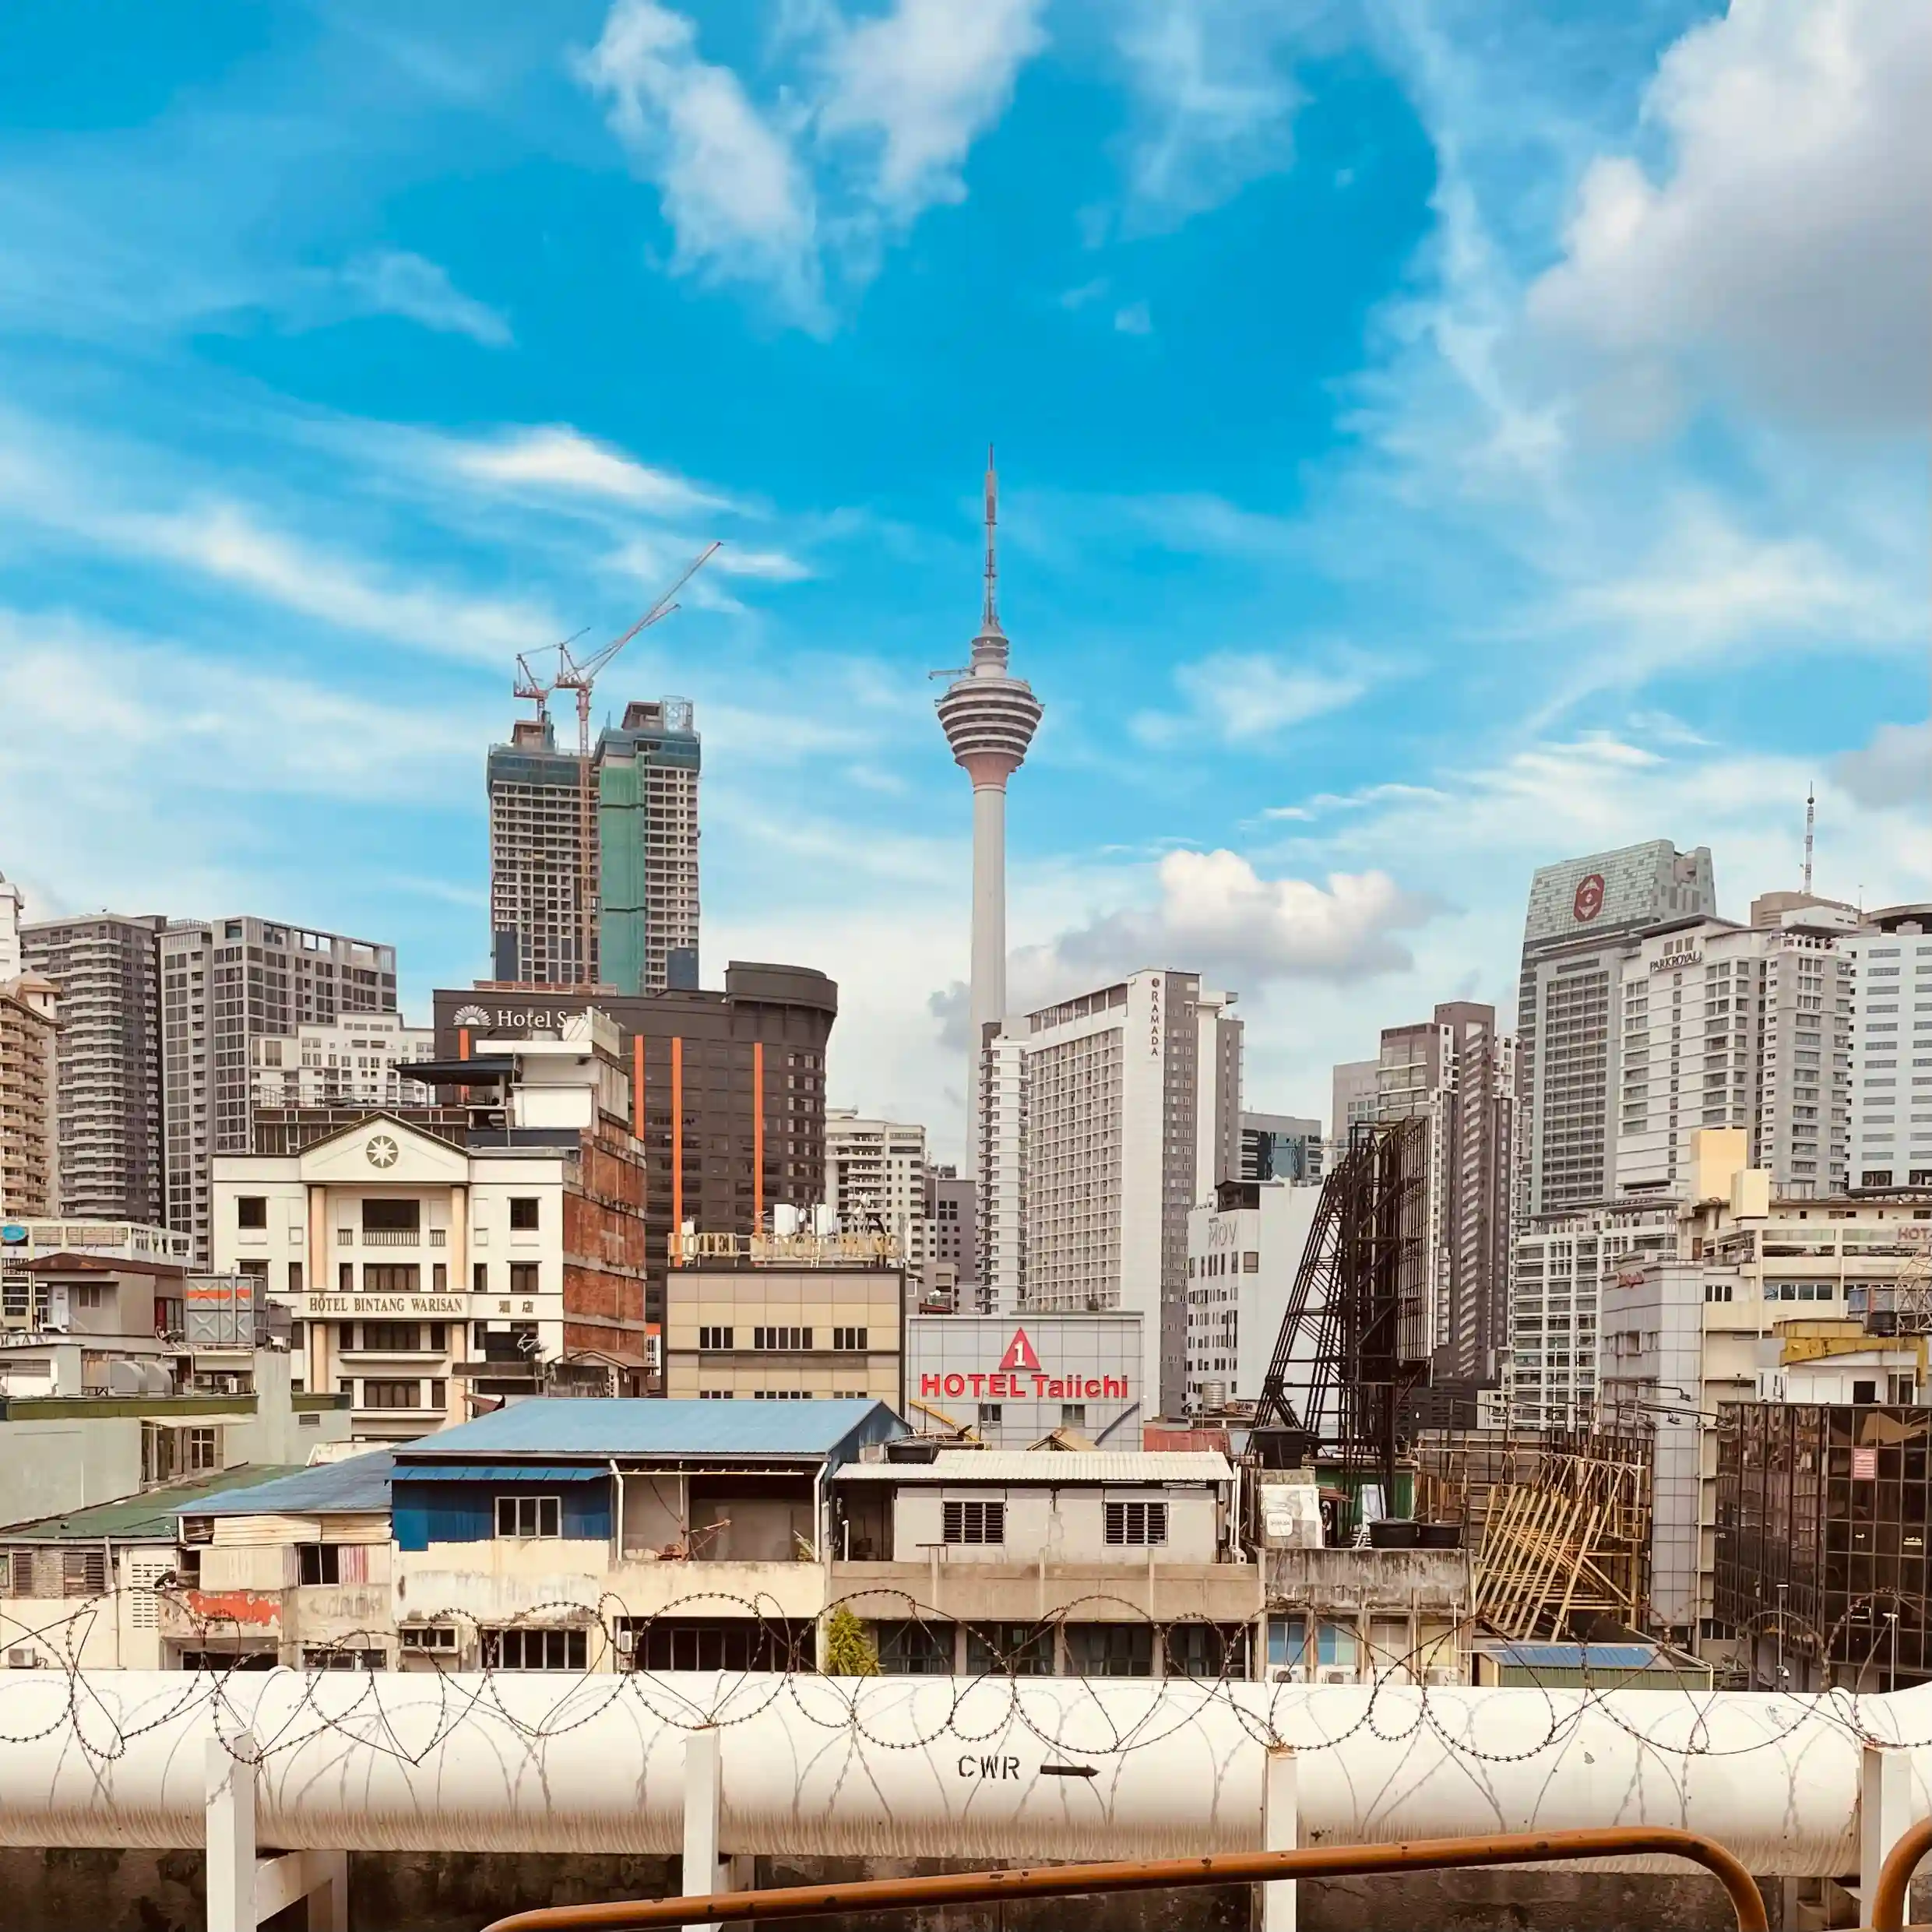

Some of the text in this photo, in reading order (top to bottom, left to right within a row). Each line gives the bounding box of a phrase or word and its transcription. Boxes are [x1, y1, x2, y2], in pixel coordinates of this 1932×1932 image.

[497, 1009, 551, 1029] Hotel
[309, 1297, 463, 1313] HOTEL BINTANG WARISAN
[1013, 1340, 1026, 1367] 1
[921, 1374, 1128, 1398] HOTEL Taiichi
[958, 1754, 1020, 1780] CWR
